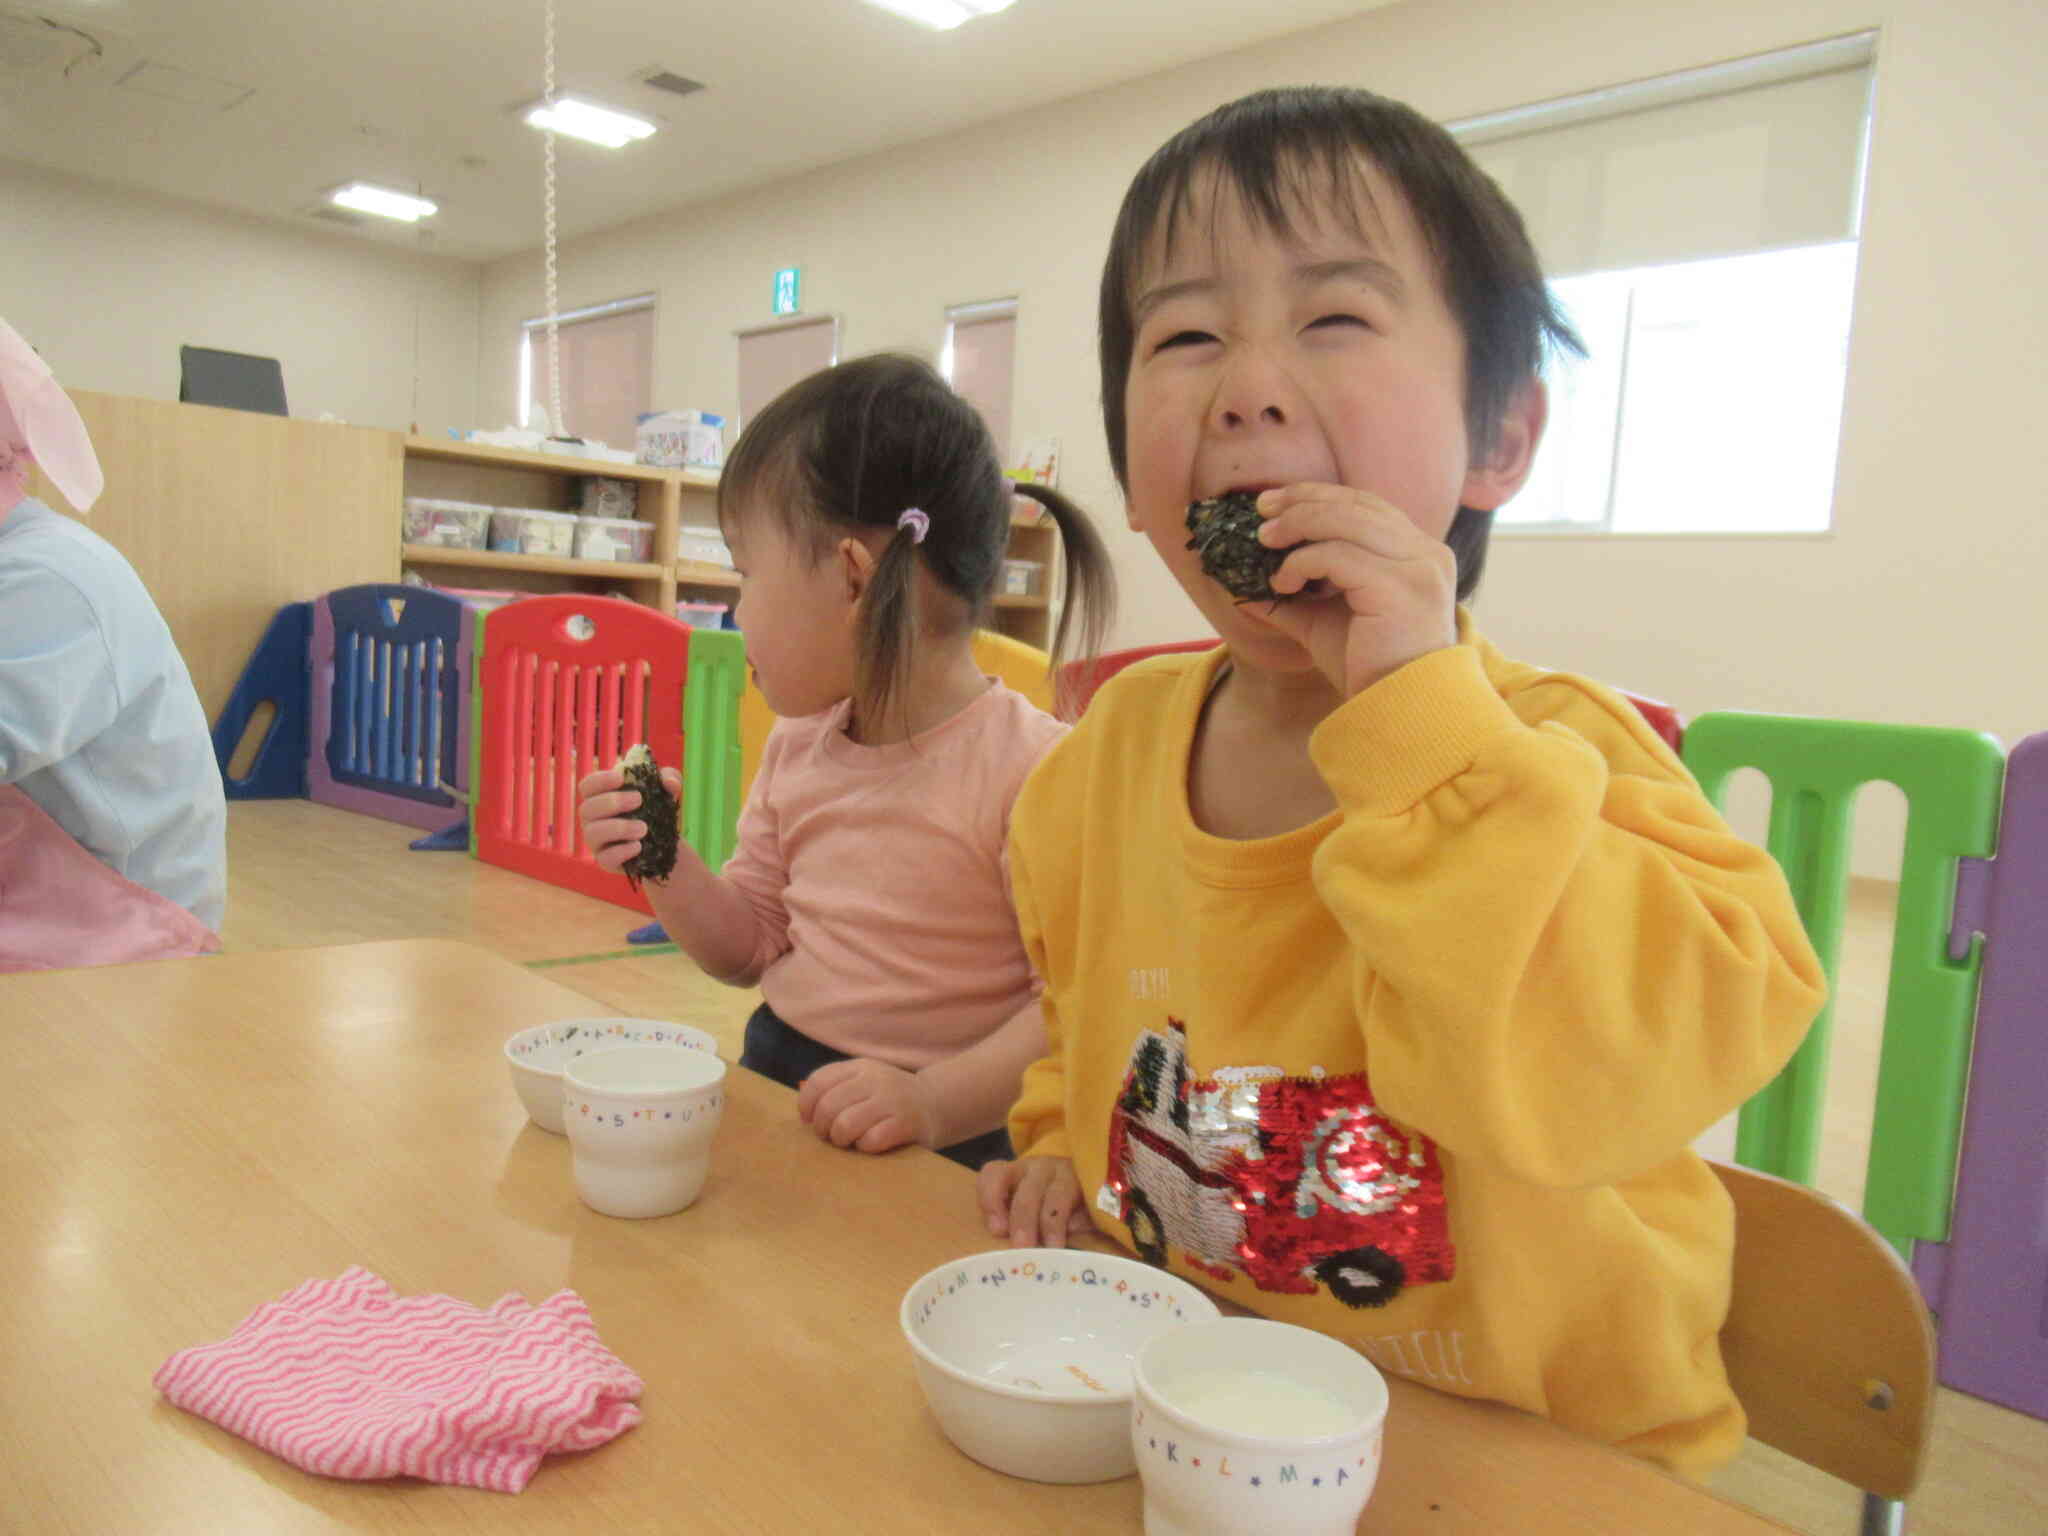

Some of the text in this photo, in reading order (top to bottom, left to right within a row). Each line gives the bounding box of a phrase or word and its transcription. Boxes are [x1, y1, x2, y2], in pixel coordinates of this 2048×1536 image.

[613, 1113, 625, 1129] S
[639, 1108, 657, 1122] T
[1080, 1268, 1099, 1286] Q
[1140, 1292, 1152, 1309] S
[1166, 1440, 1179, 1463] K
[1216, 1455, 1233, 1478] L
[1279, 1464, 1299, 1484] M
